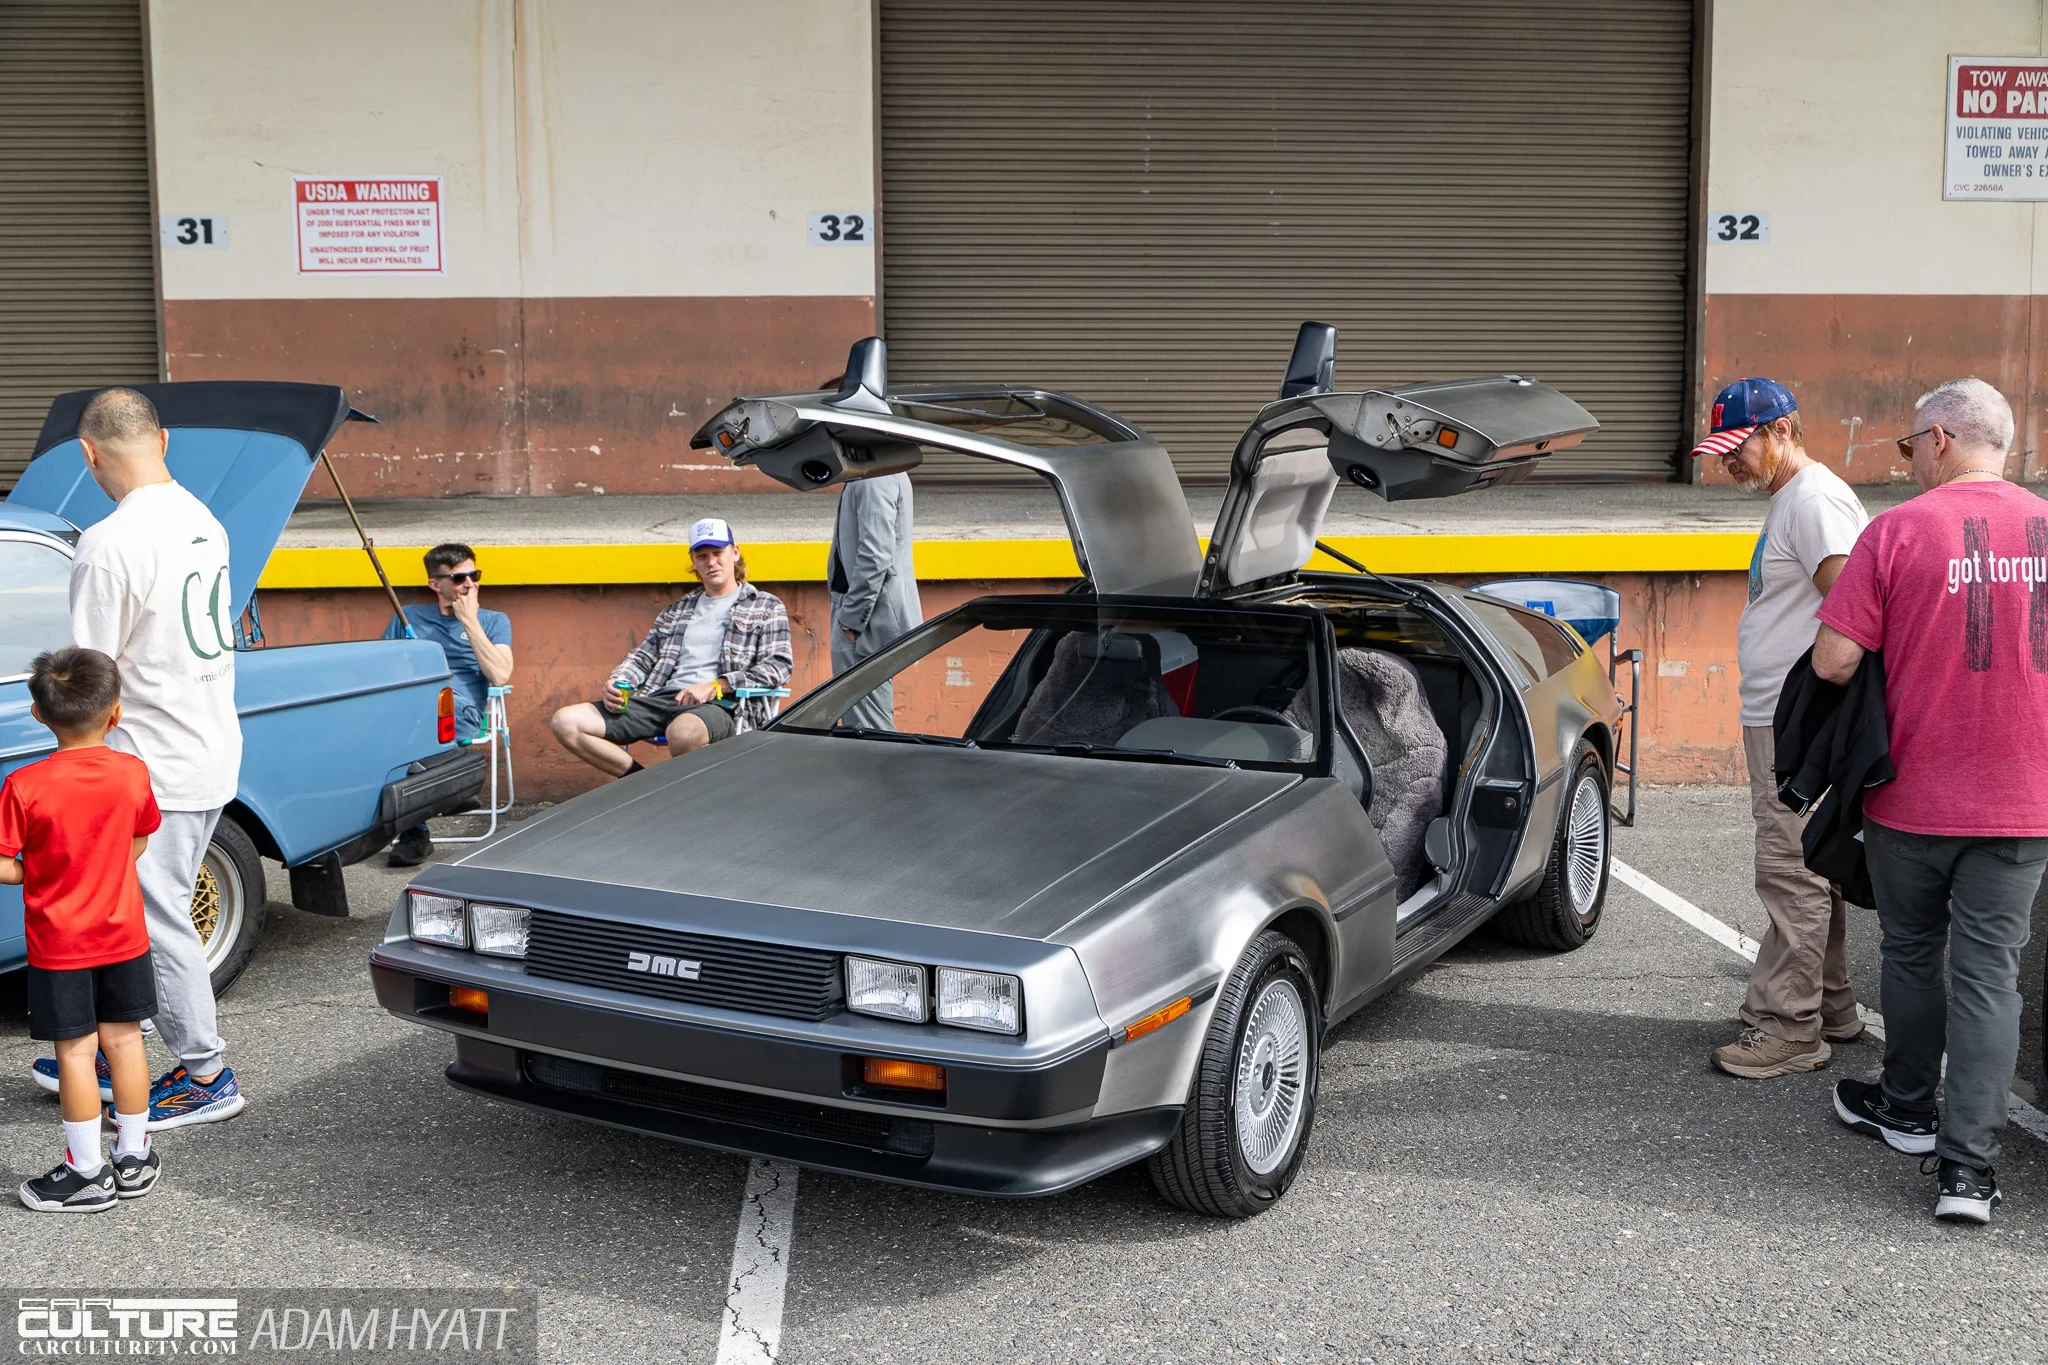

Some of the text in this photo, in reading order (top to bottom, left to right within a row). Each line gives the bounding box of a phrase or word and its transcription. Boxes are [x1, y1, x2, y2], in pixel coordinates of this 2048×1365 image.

[1970, 71, 2006, 87] TOW
[1963, 90, 2048, 115] NO PAR
[1956, 126, 2048, 140] VIOLATING VEHIC
[1966, 145, 2002, 158] TOWED
[2008, 145, 2039, 159] AWAY
[1984, 164, 2033, 177] OWNER'S
[305, 183, 430, 200] USDA WARNING
[1953, 184, 1970, 192] CVC
[306, 208, 330, 216] UNDER
[332, 208, 345, 216] THE
[347, 208, 369, 216] PLANT
[417, 207, 430, 215] ACT
[306, 219, 314, 227] OF
[335, 219, 382, 227] SUBSTANTIAL
[819, 214, 864, 242] 32
[1717, 214, 1760, 241] 32
[176, 217, 213, 245] 31
[385, 256, 422, 264] PENALTIES
[1948, 550, 2047, 594] got torqu
